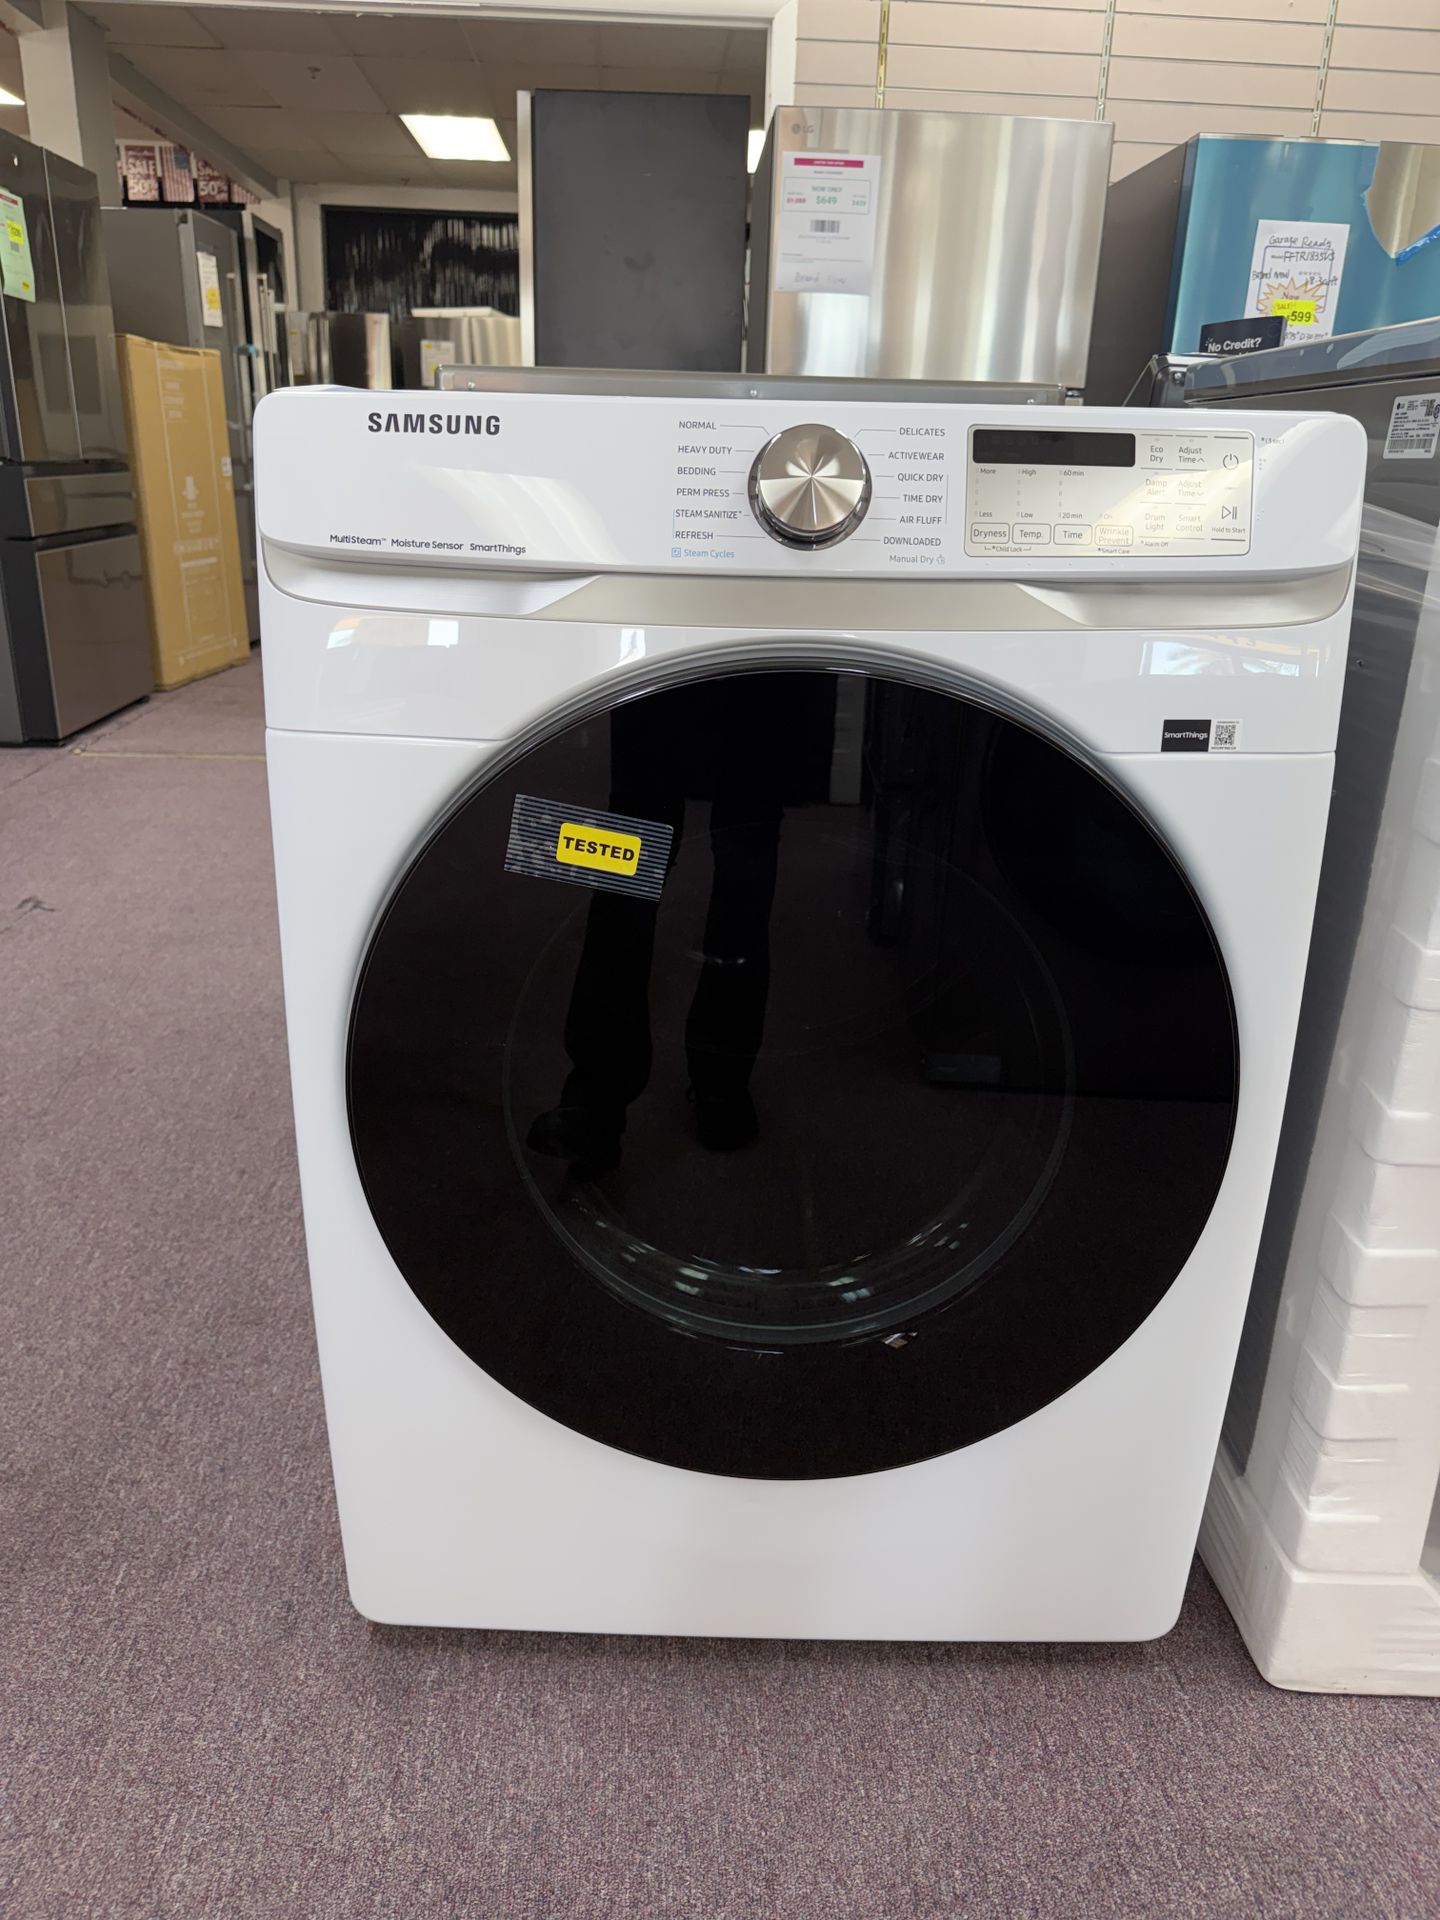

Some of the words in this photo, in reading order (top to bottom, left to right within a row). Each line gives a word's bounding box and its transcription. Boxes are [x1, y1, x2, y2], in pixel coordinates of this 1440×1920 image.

[128, 157, 156, 175] SALE
[816, 195, 837, 205] $649
[1269, 235, 1298, 248] Garage
[1302, 236, 1332, 252] Ready
[1208, 342, 1221, 353] No
[1223, 336, 1262, 350] Credit?
[368, 412, 501, 435] SAMSUNG
[679, 421, 717, 430] NORMAL
[899, 427, 946, 437] DELICATES
[678, 445, 708, 454] HEAVY
[709, 446, 733, 455] DUTY
[1150, 445, 1163, 453] Eco
[1178, 447, 1202, 456] Adjust
[888, 451, 945, 461] ACTIVEWEAR
[1150, 455, 1164, 463] Dry
[1178, 456, 1197, 464] Time
[677, 466, 717, 476] BEDDING
[897, 473, 924, 482] QUICK
[926, 473, 944, 482] DRY
[1145, 479, 1168, 489] Damp
[1178, 481, 1201, 489] Adjust
[676, 488, 701, 496] PERM
[703, 489, 730, 497] PRESS
[1146, 488, 1165, 496] Alert
[903, 494, 924, 503] TIME
[925, 495, 943, 503] DRY
[675, 509, 703, 518] STEAM
[1145, 513, 1166, 521] Drum
[1178, 514, 1200, 522] Smart
[899, 516, 914, 524] AIR
[916, 516, 942, 525] FLUFF
[1099, 528, 1129, 536] Wrinkle
[1145, 523, 1164, 532] Light
[675, 530, 714, 540] REFRESH
[973, 529, 1007, 539] Dryness
[1063, 530, 1083, 539] Time
[883, 536, 942, 546] DOWNLOADED
[1098, 536, 1129, 544] Prevent
[391, 539, 431, 549] Moisture
[432, 540, 464, 551] Sensor
[470, 543, 526, 556] SmartThings
[683, 549, 709, 558] Steam
[710, 549, 735, 560] Cycles
[889, 554, 918, 563] Manual
[920, 555, 934, 565] Dry
[1164, 731, 1208, 740] SmartThings
[562, 836, 635, 862] TESTED
